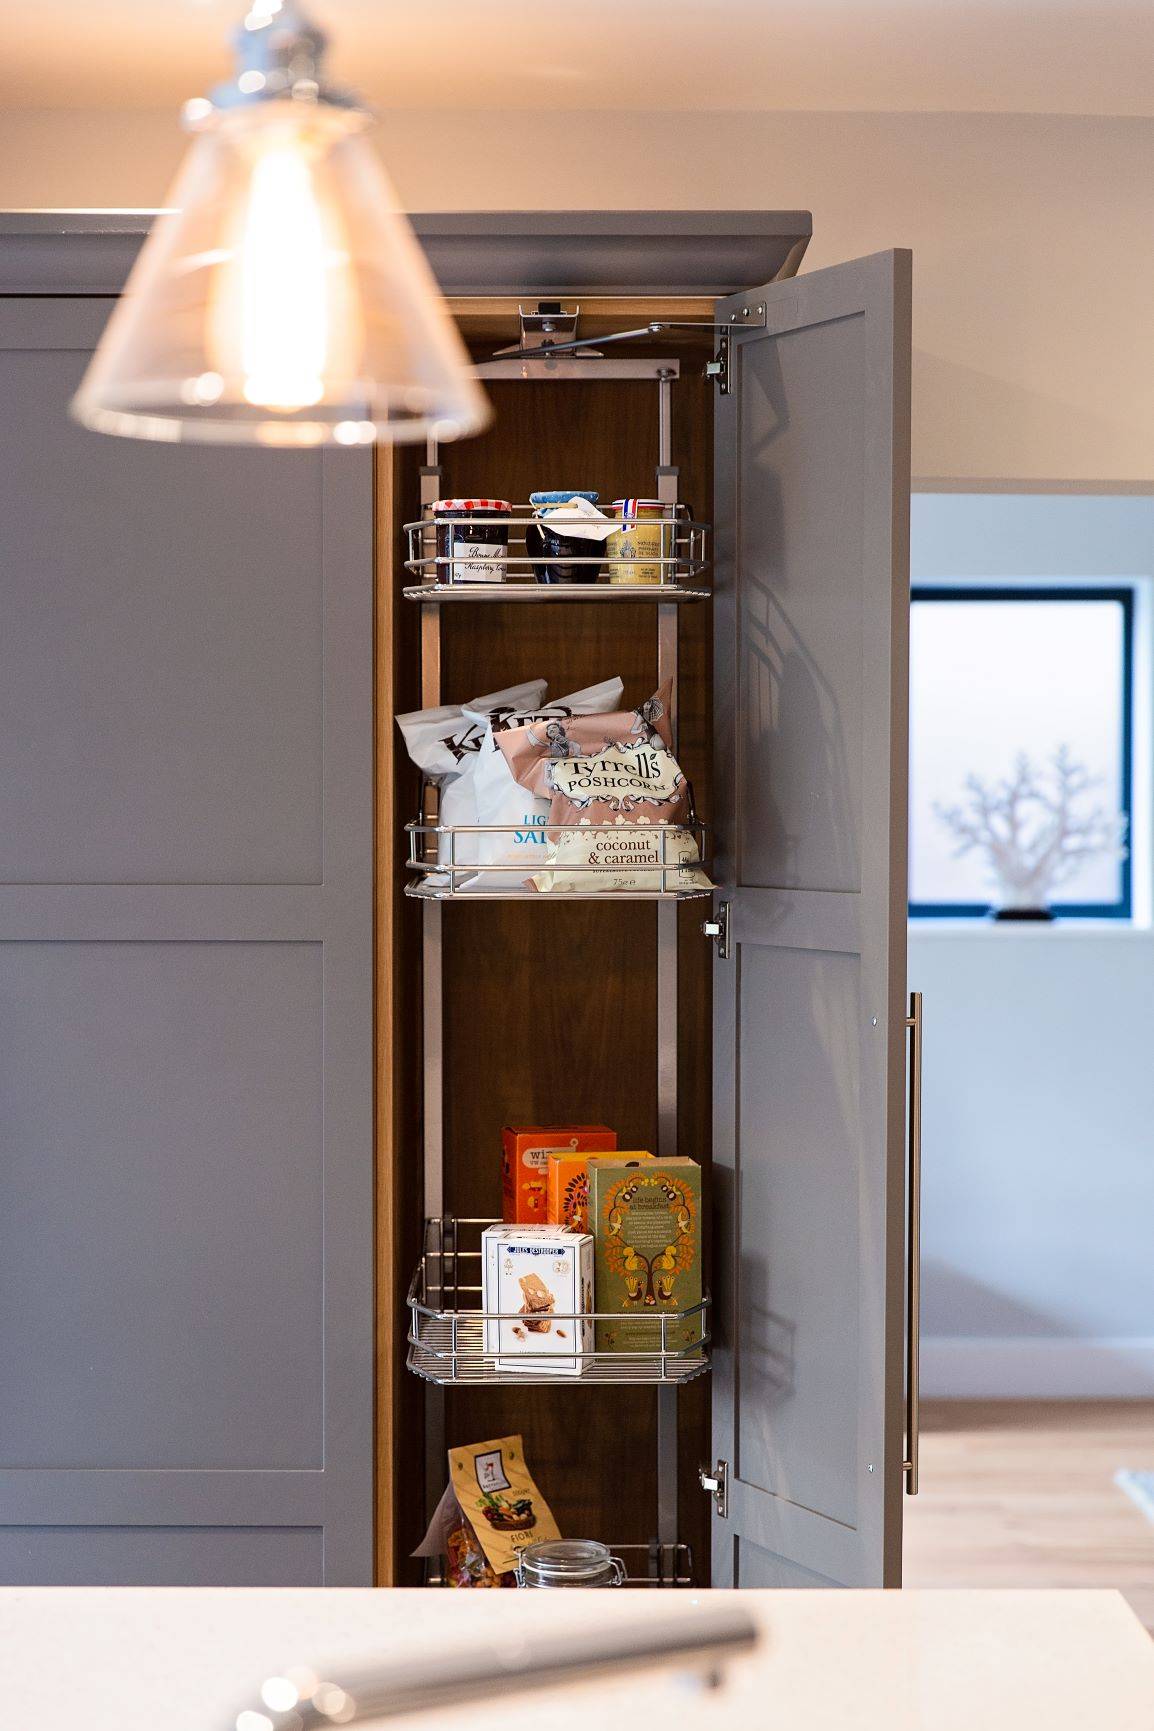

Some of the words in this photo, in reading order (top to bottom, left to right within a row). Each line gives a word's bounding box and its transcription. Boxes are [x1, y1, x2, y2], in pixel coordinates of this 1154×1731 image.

[568, 777, 666, 792] POSHCORN
[596, 840, 651, 851] coconut
[588, 851, 600, 864] &
[604, 850, 659, 864] caramel
